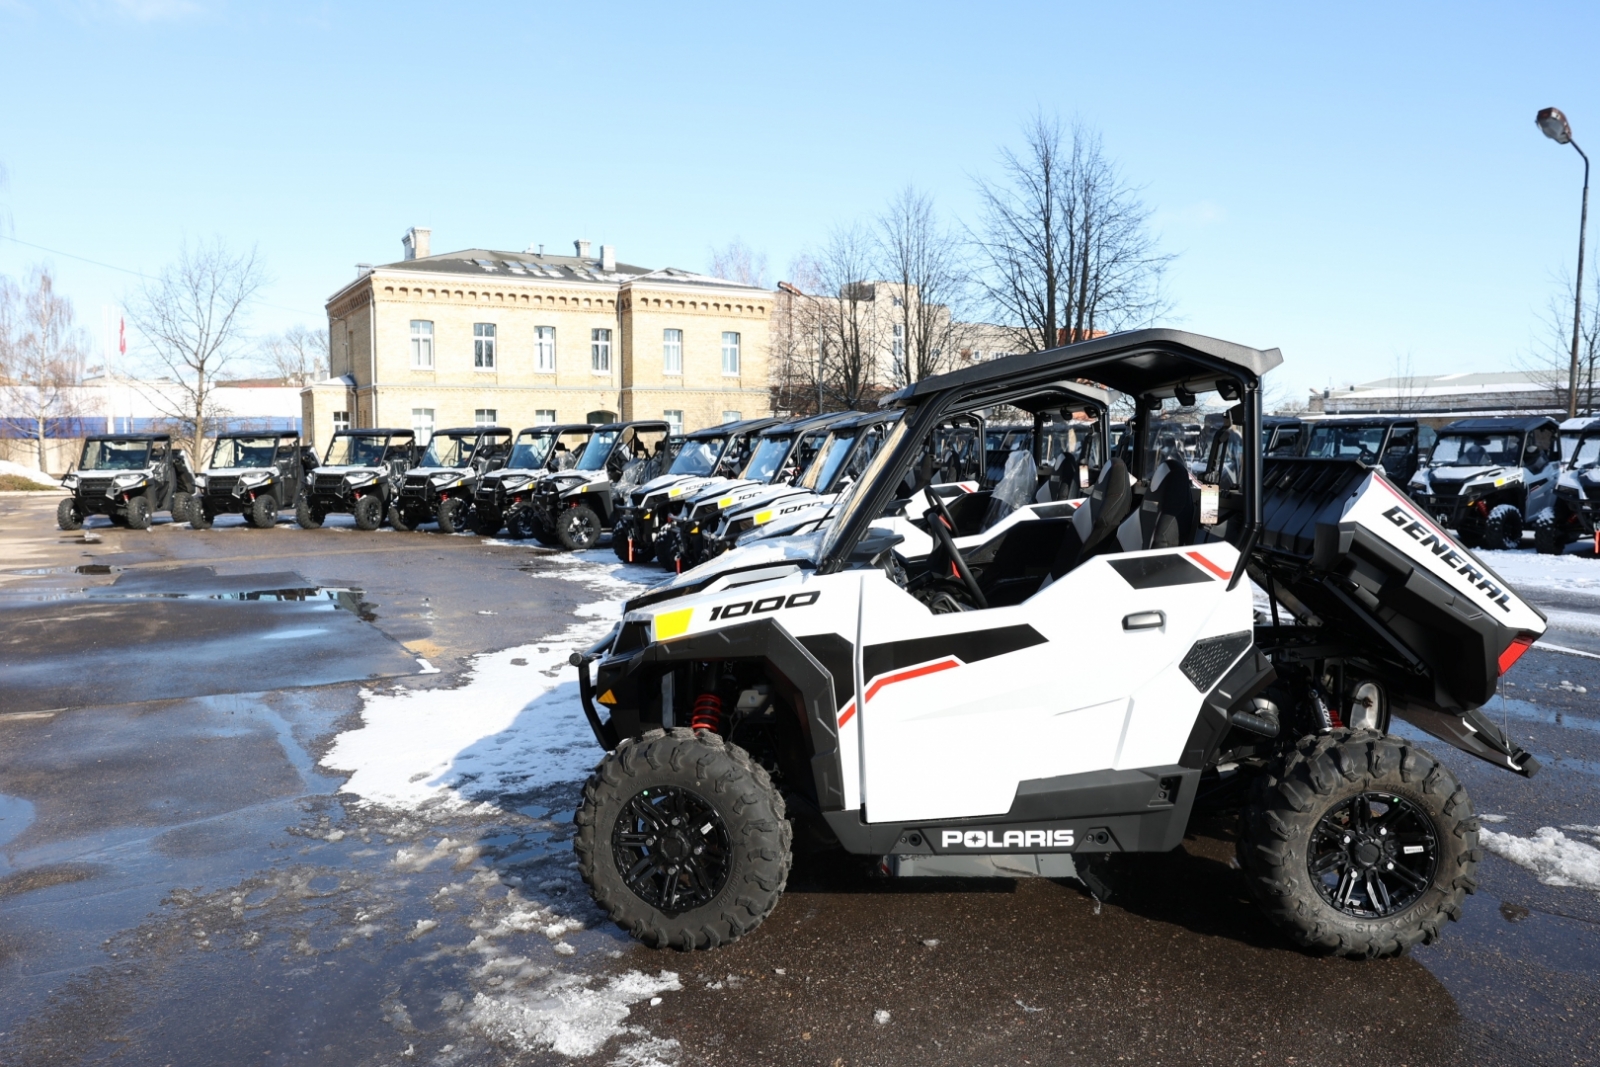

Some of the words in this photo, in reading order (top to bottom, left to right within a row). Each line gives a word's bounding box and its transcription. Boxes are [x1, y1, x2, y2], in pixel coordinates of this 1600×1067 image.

[1381, 505, 1511, 613] GENERAL
[709, 590, 821, 622] 1000
[941, 829, 1075, 848] POLARIS
[717, 860, 743, 908] CORONADO
[1355, 902, 1430, 934] MAXXIS
